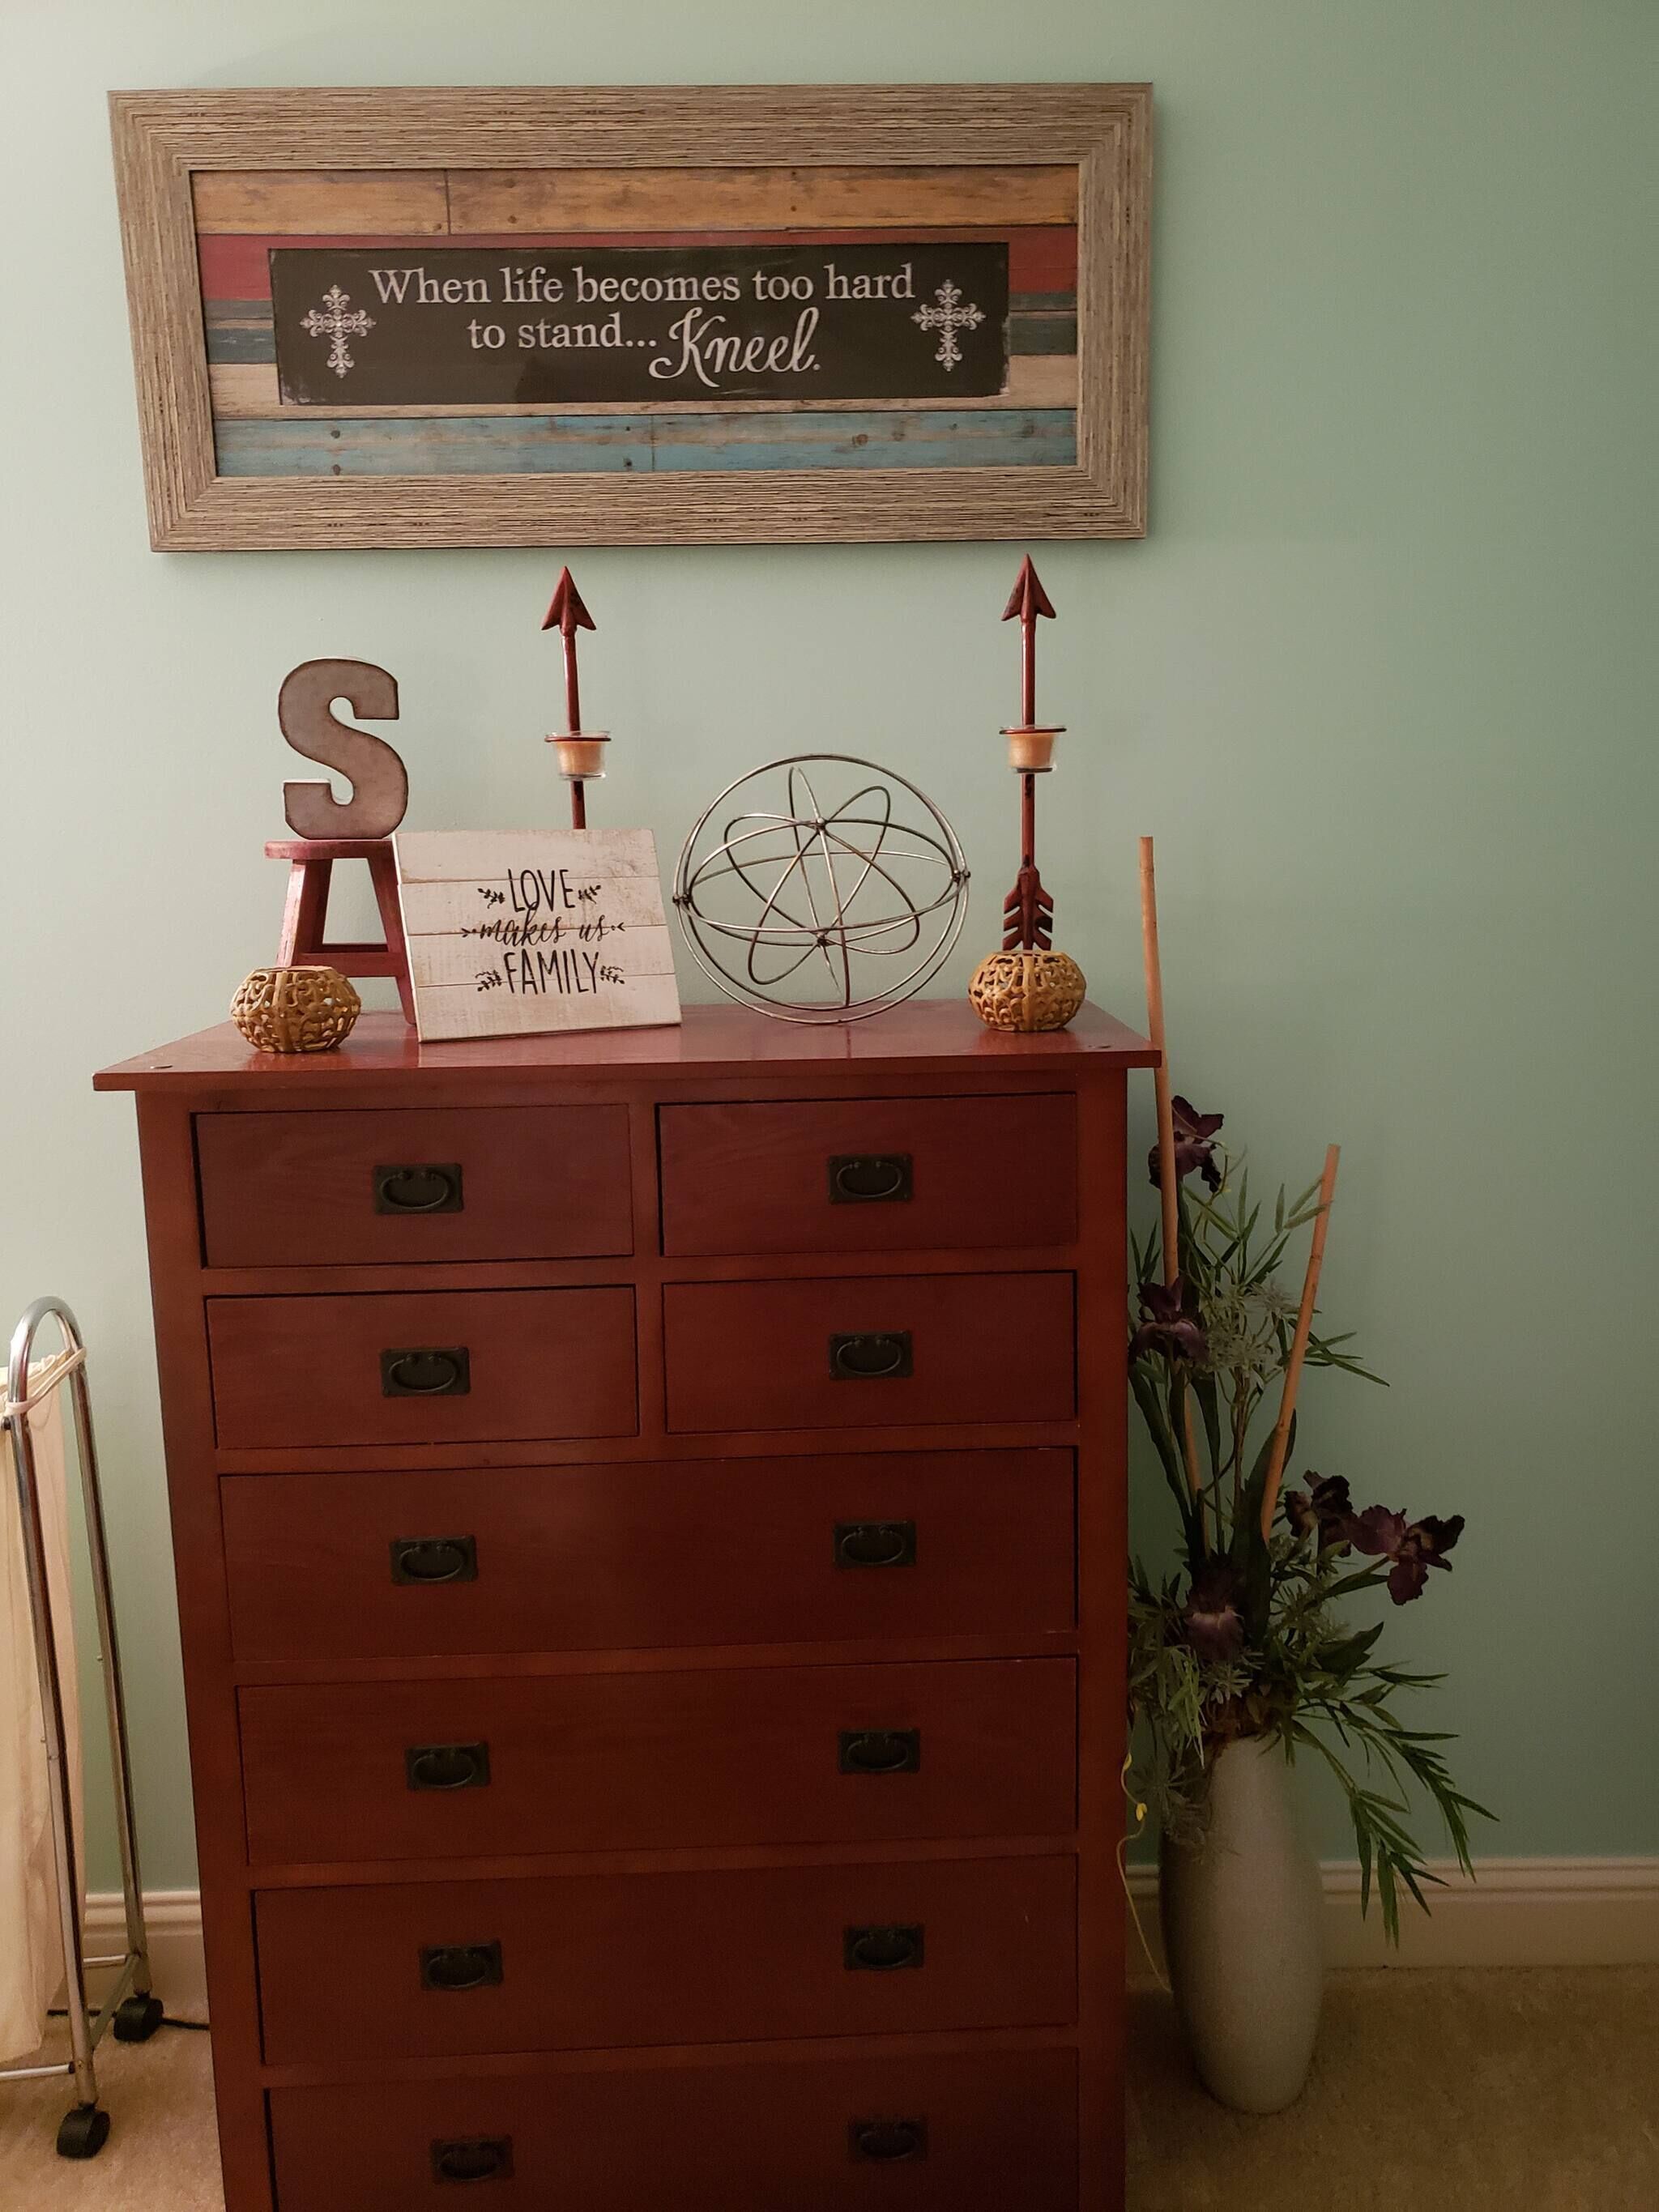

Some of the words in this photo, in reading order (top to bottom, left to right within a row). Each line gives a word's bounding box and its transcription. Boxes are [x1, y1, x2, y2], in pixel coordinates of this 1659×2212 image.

[368, 267, 492, 304] When
[499, 266, 563, 303] life
[572, 266, 740, 303] becomes
[752, 267, 812, 302] too
[823, 262, 916, 300] hard
[467, 317, 506, 350] to
[518, 312, 658, 349] stand...
[649, 307, 821, 386] Kneel.
[278, 658, 408, 840] S
[508, 868, 576, 912] LOVE
[480, 901, 566, 947] makes
[579, 914, 609, 942] us
[503, 948, 599, 995] FAMILY
